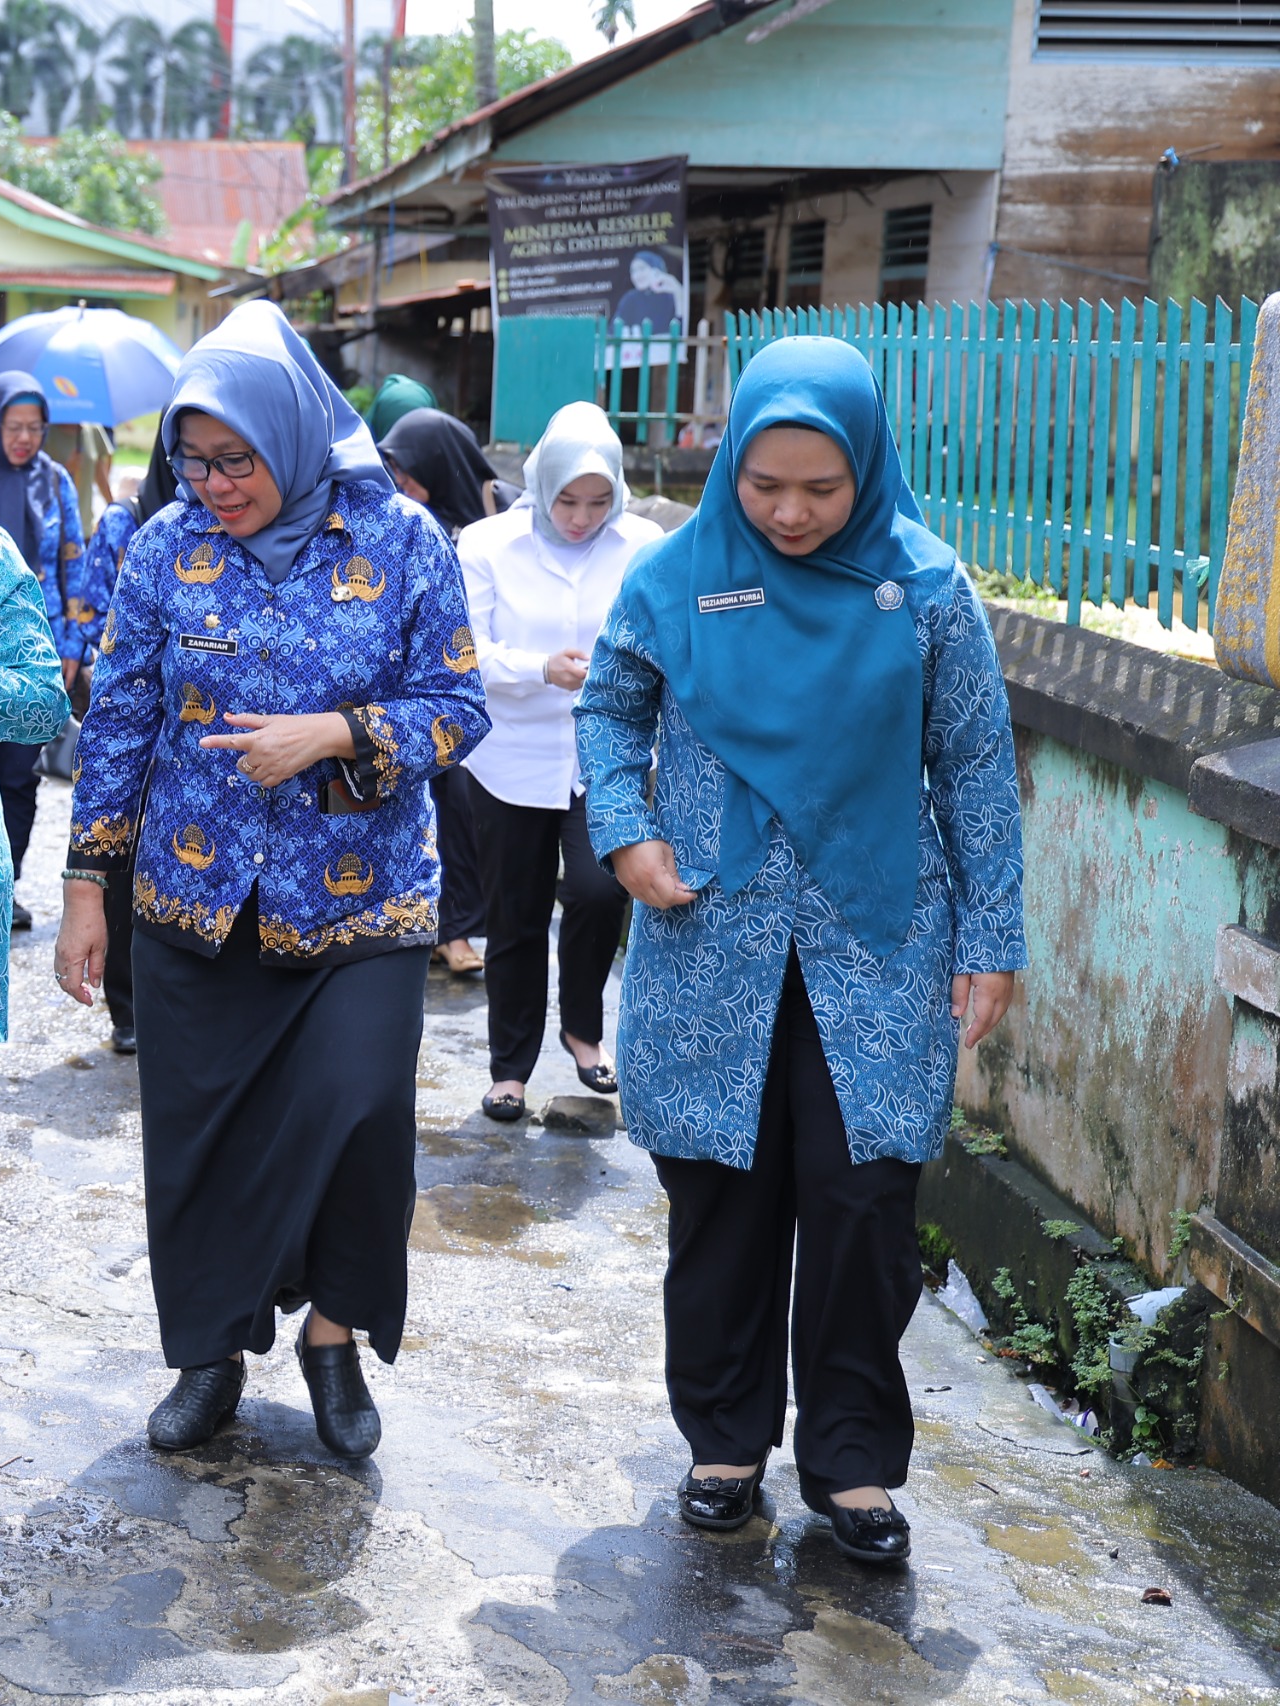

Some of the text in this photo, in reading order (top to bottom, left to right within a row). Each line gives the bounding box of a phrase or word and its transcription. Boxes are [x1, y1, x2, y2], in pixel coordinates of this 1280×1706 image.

[605, 181, 680, 200] PALEMBANG
[503, 211, 674, 244] MENERIMA RESSELER
[510, 229, 669, 259] AGEN & DISTRIBUTOR
[700, 592, 762, 608] REZIANDHA PURBA
[187, 638, 229, 651] ZANARIAH
